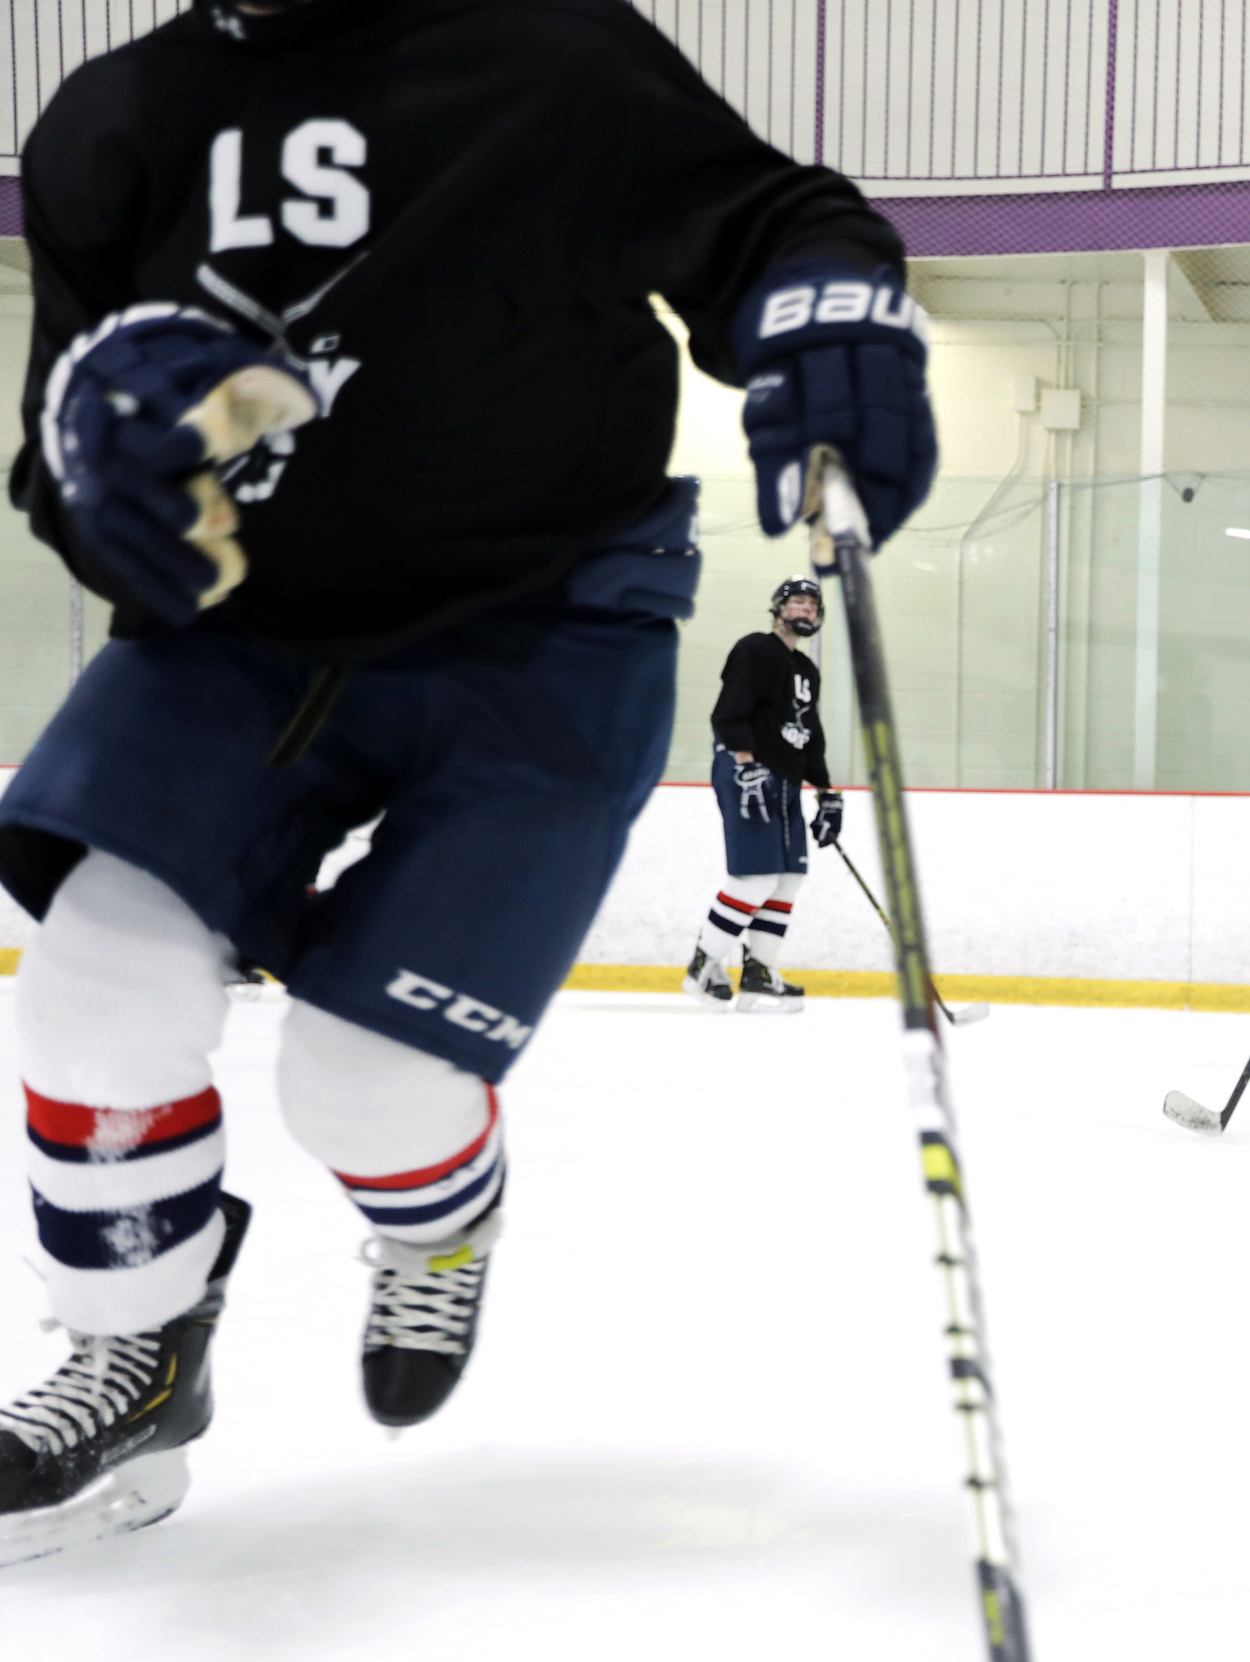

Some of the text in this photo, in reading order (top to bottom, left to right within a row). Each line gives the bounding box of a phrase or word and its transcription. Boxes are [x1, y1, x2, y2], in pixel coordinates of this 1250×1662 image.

[209, 117, 371, 253] LS
[794, 673, 812, 703] LS
[385, 967, 534, 1050] CCM
